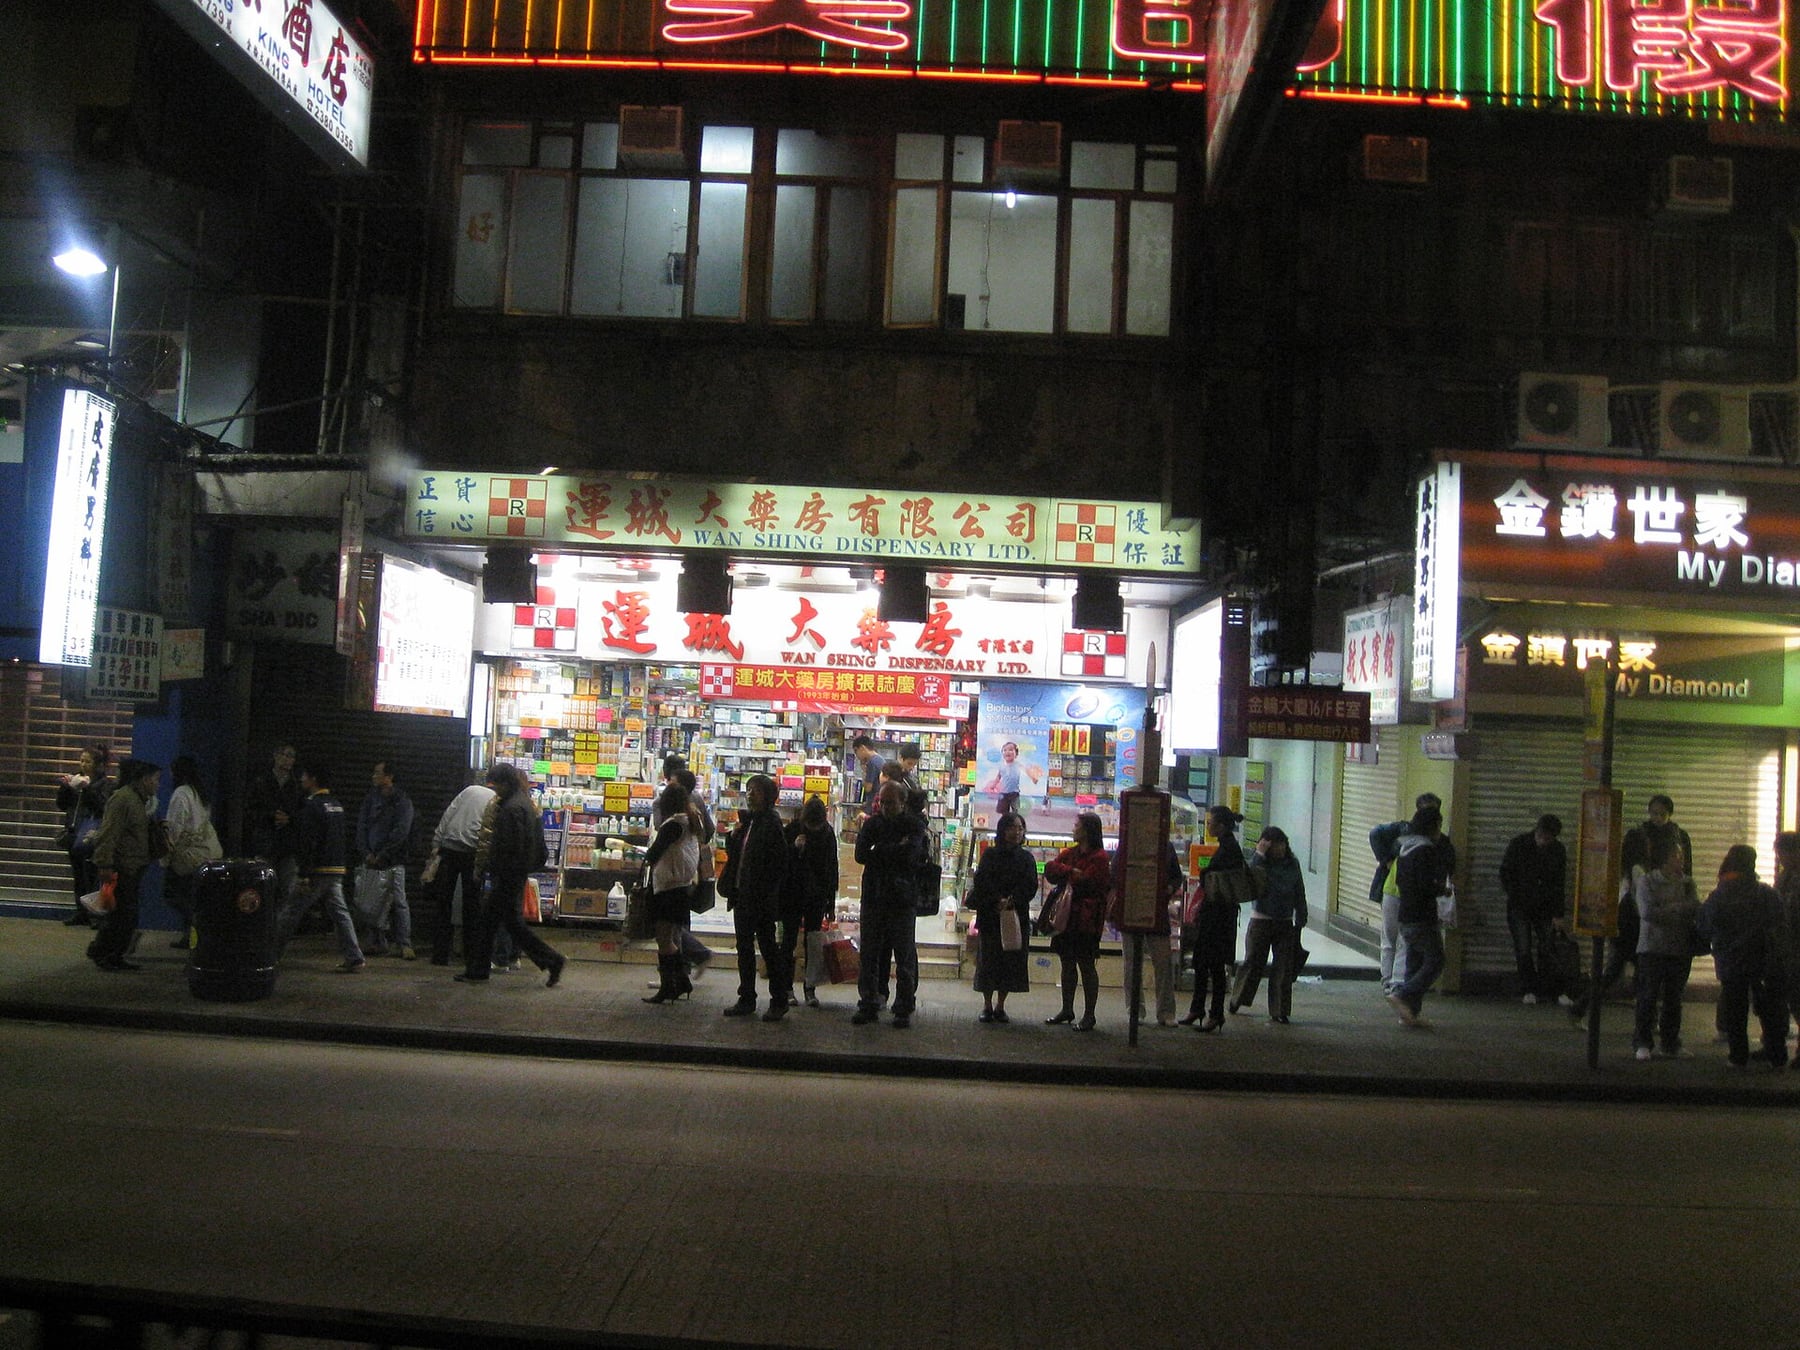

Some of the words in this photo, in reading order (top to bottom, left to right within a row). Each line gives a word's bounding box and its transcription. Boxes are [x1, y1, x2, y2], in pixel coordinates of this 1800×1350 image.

[258, 27, 290, 70] KING
[308, 78, 347, 129] HOTEL
[314, 106, 334, 132] 2380
[416, 509, 474, 533] 信心
[565, 482, 1037, 545] 運城大藥房有限公司
[1494, 478, 1750, 549] 金鑽世家
[694, 530, 742, 547] WAN
[754, 533, 823, 551] SHING
[836, 536, 976, 558] DISPENSARY
[988, 544, 1037, 561] LTD.
[1677, 551, 1726, 587] My
[1741, 554, 1800, 586] Dia
[781, 651, 816, 665] WAN
[827, 653, 876, 668] SHING
[888, 656, 986, 673] DISPENSARY
[998, 660, 1032, 675] LTD.
[735, 668, 915, 695] 運城大藥房擴張誌慶
[1650, 675, 1749, 698] Diamond
